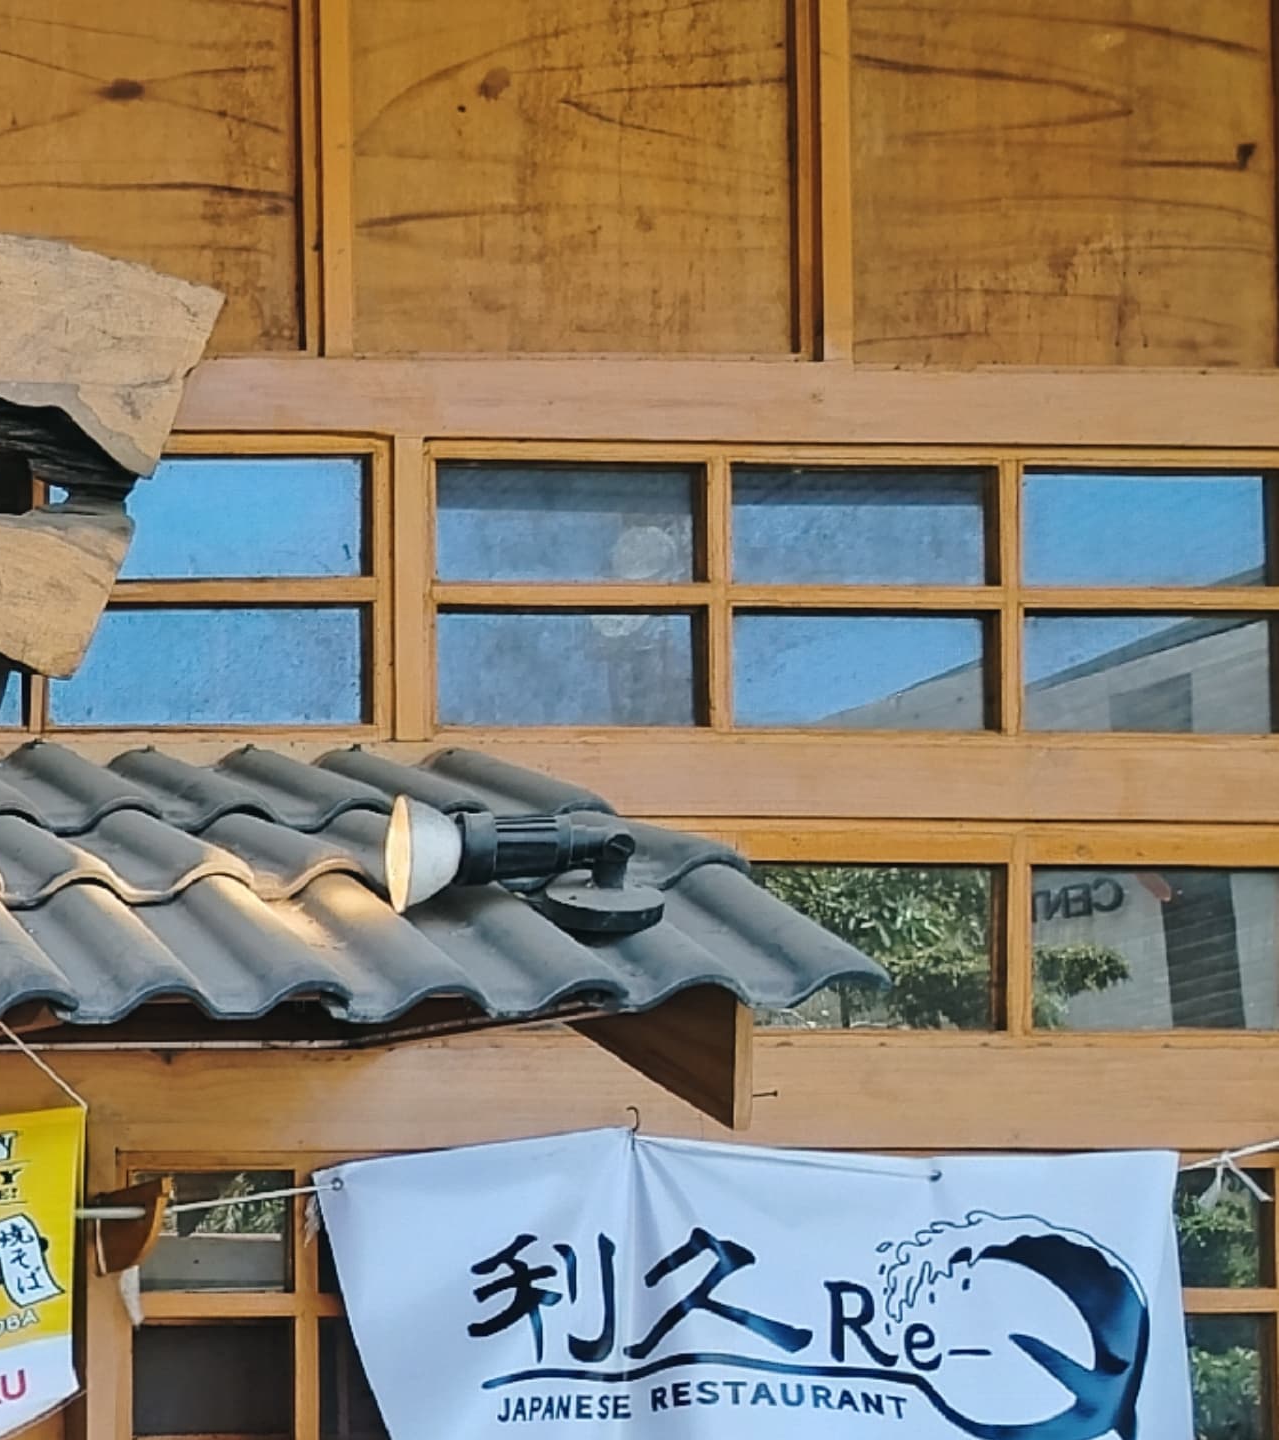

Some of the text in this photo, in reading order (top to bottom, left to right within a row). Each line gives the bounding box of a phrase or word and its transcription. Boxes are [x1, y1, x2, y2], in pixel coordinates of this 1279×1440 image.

[467, 1227, 812, 1363] 利久
[496, 1380, 907, 1422] JAPANESE RESTAURANT
